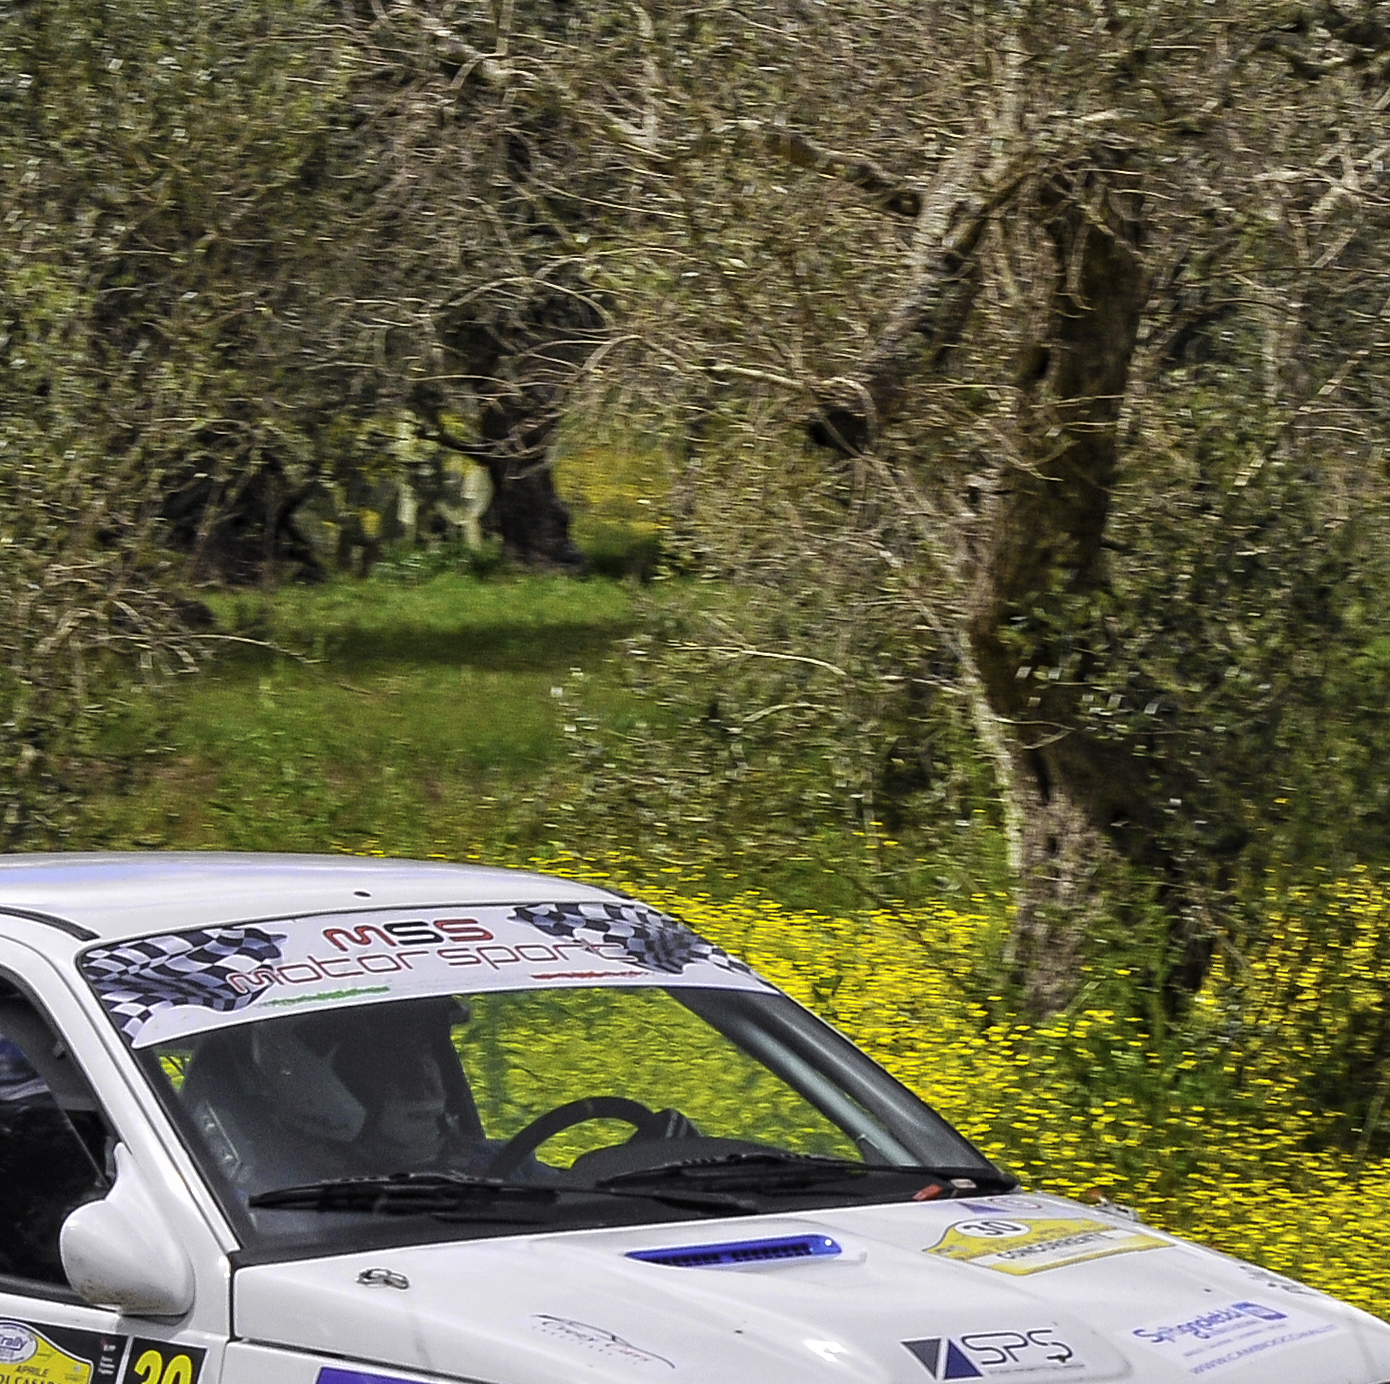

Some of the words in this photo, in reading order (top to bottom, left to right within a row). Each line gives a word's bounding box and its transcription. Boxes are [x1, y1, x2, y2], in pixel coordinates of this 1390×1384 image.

[322, 917, 494, 952] MSS
[963, 1219, 1022, 1236] 30
[960, 1328, 1073, 1366] SPS
[15, 1365, 50, 1378] APRILE
